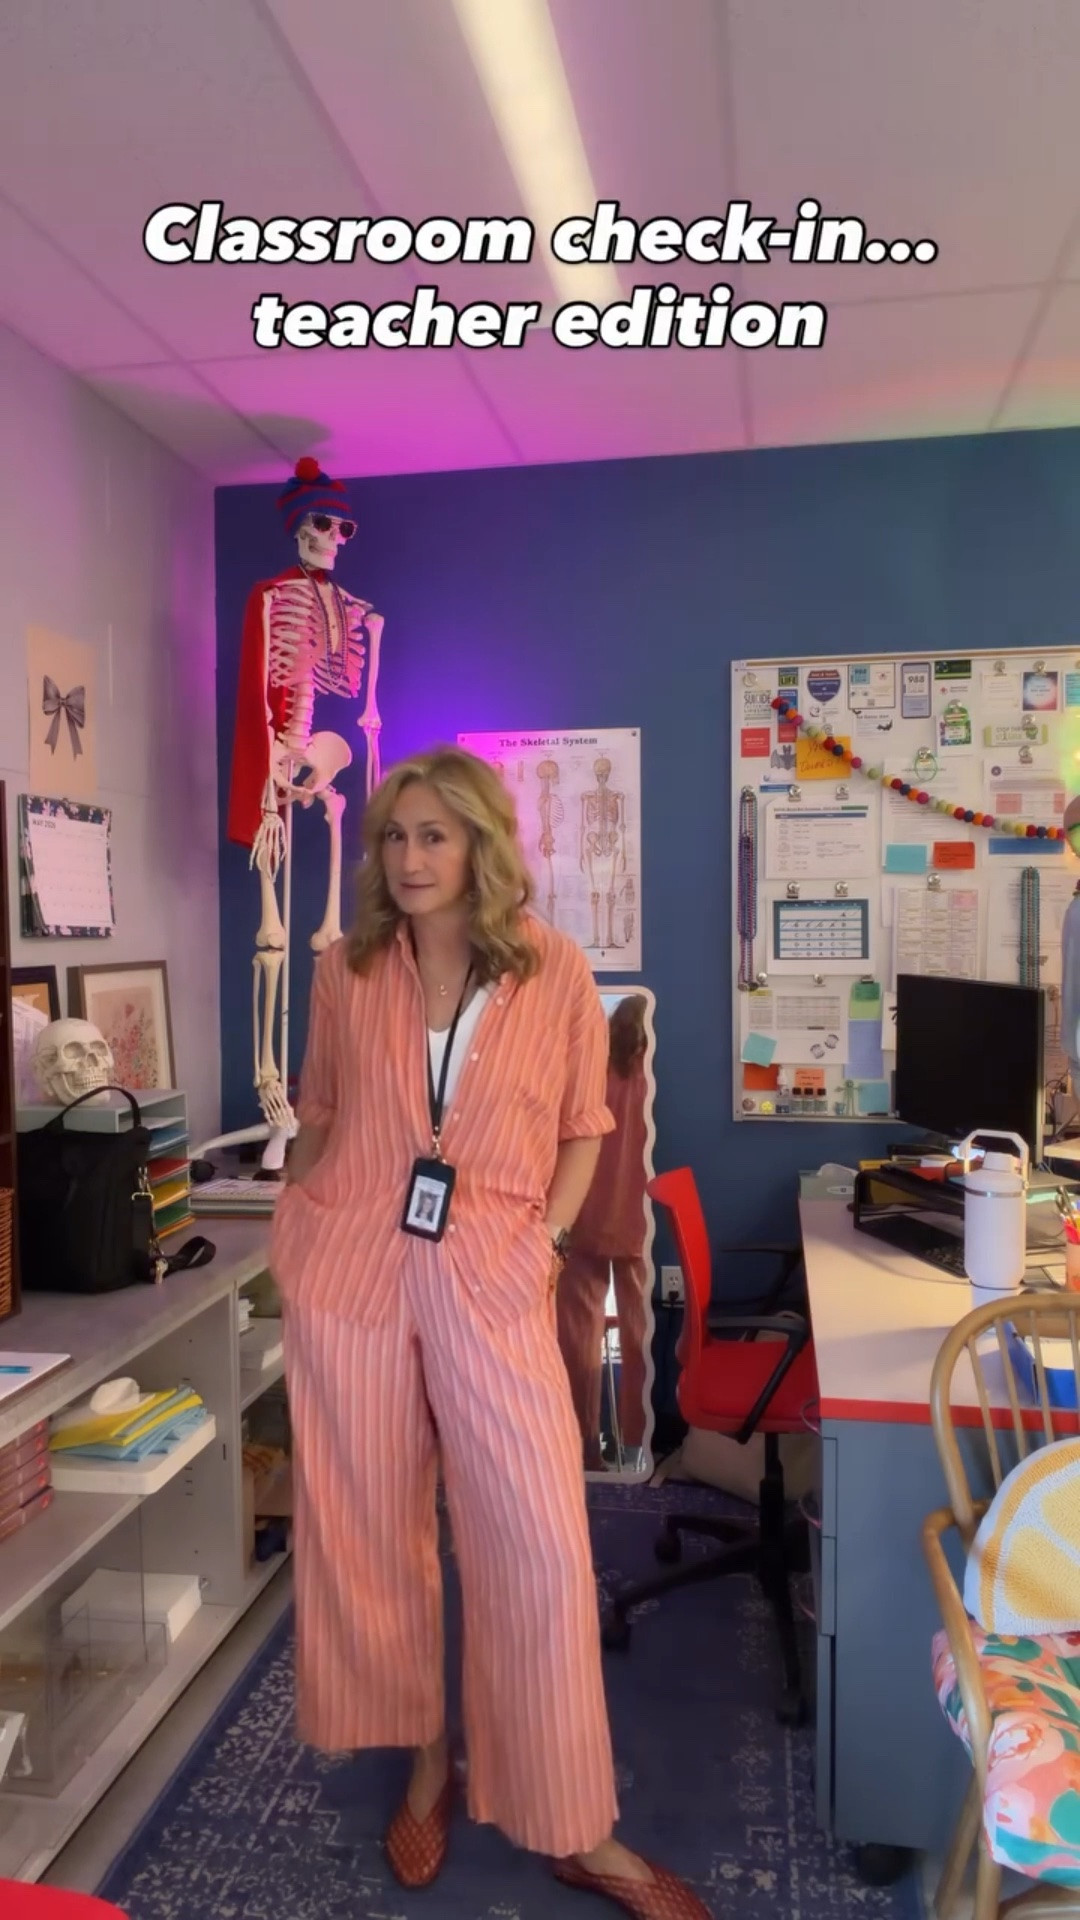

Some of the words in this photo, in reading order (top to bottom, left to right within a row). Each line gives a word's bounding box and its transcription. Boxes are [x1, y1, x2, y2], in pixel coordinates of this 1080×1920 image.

[907, 675, 925, 683] 988
[743, 693, 772, 704] SUICIDE
[499, 739, 517, 747] The
[520, 737, 559, 747] Skeletal
[562, 737, 598, 747] System
